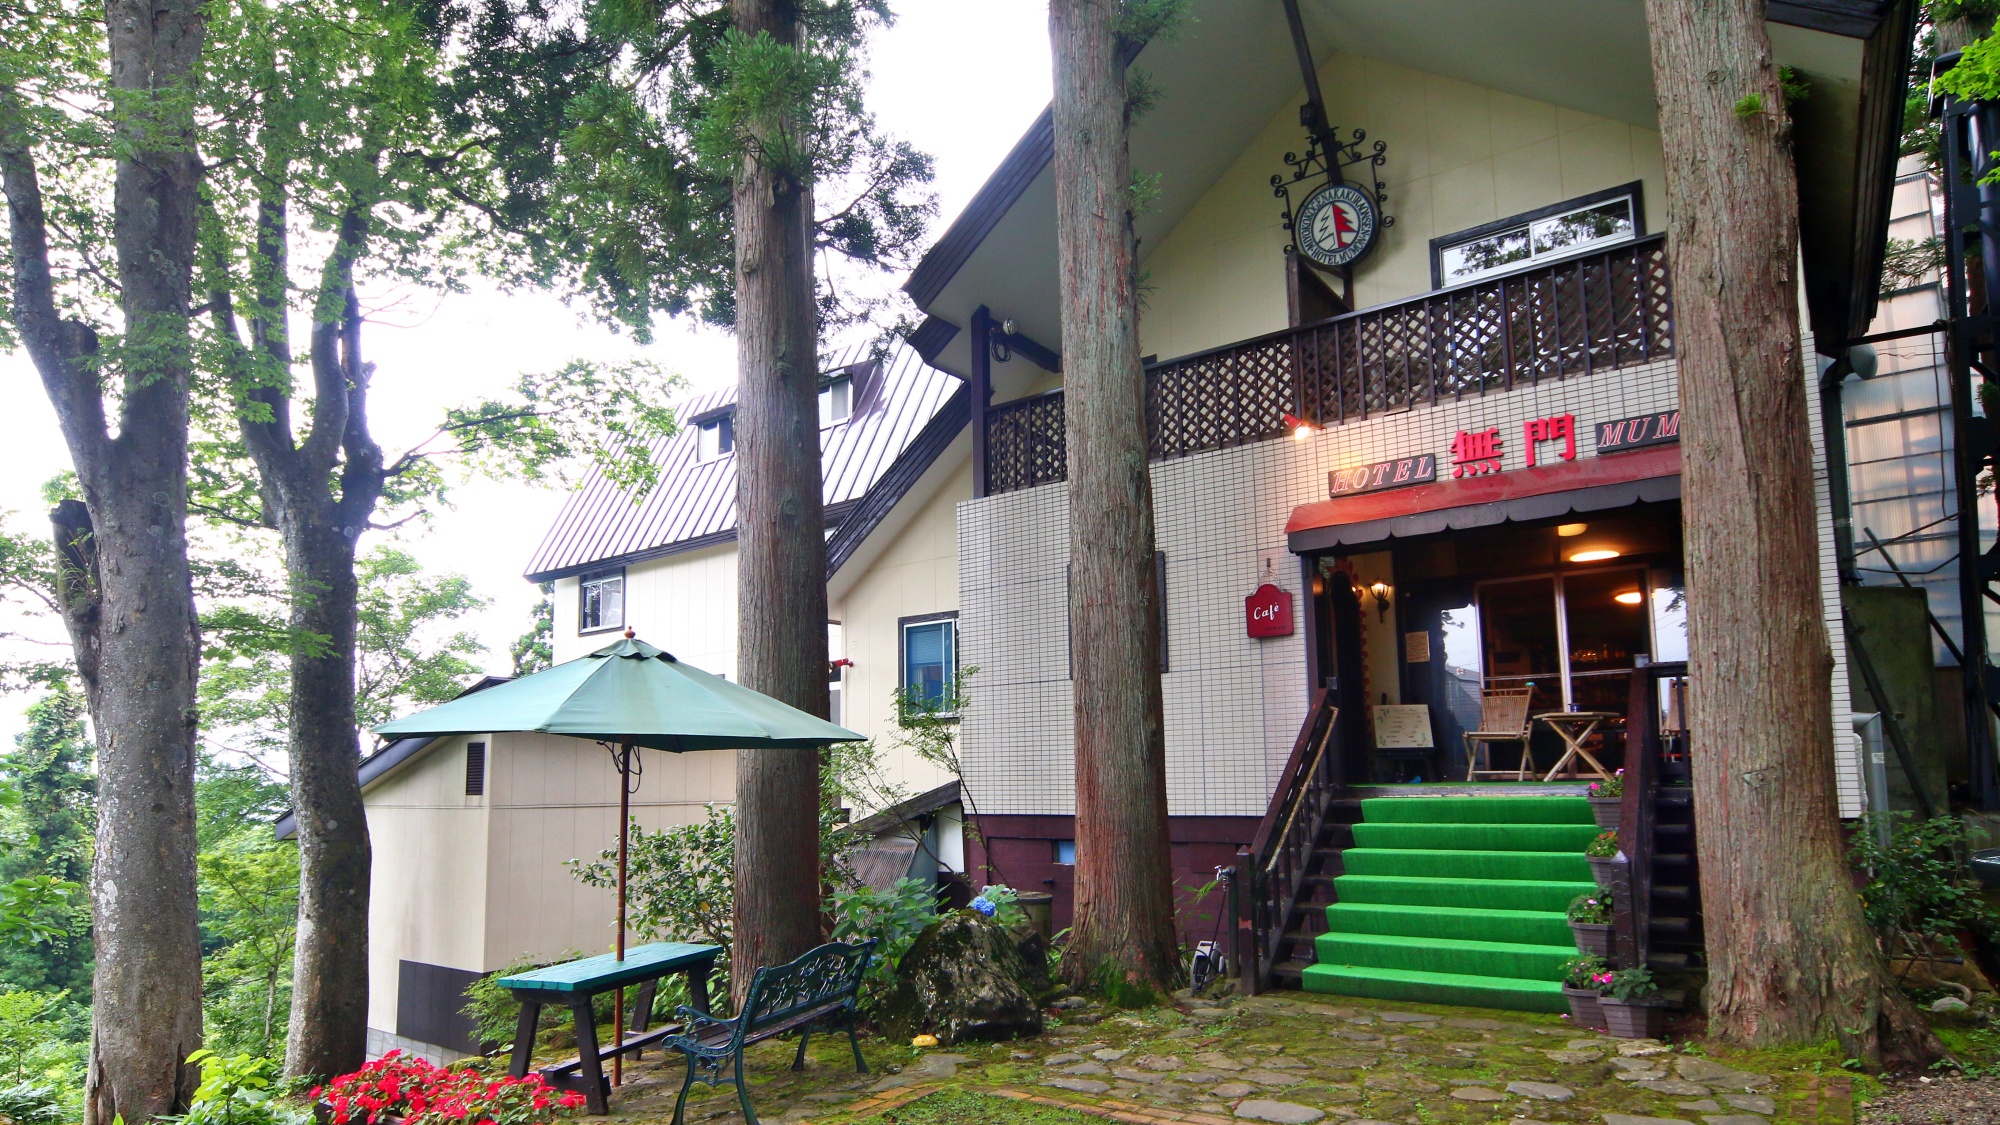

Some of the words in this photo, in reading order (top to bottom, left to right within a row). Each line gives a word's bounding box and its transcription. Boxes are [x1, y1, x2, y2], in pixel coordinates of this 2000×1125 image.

[1311, 247, 1339, 265] HOTEL
[1339, 235, 1367, 263] MUMON
[1450, 412, 1576, 478] 無門
[1331, 456, 1432, 493] HOTEL
